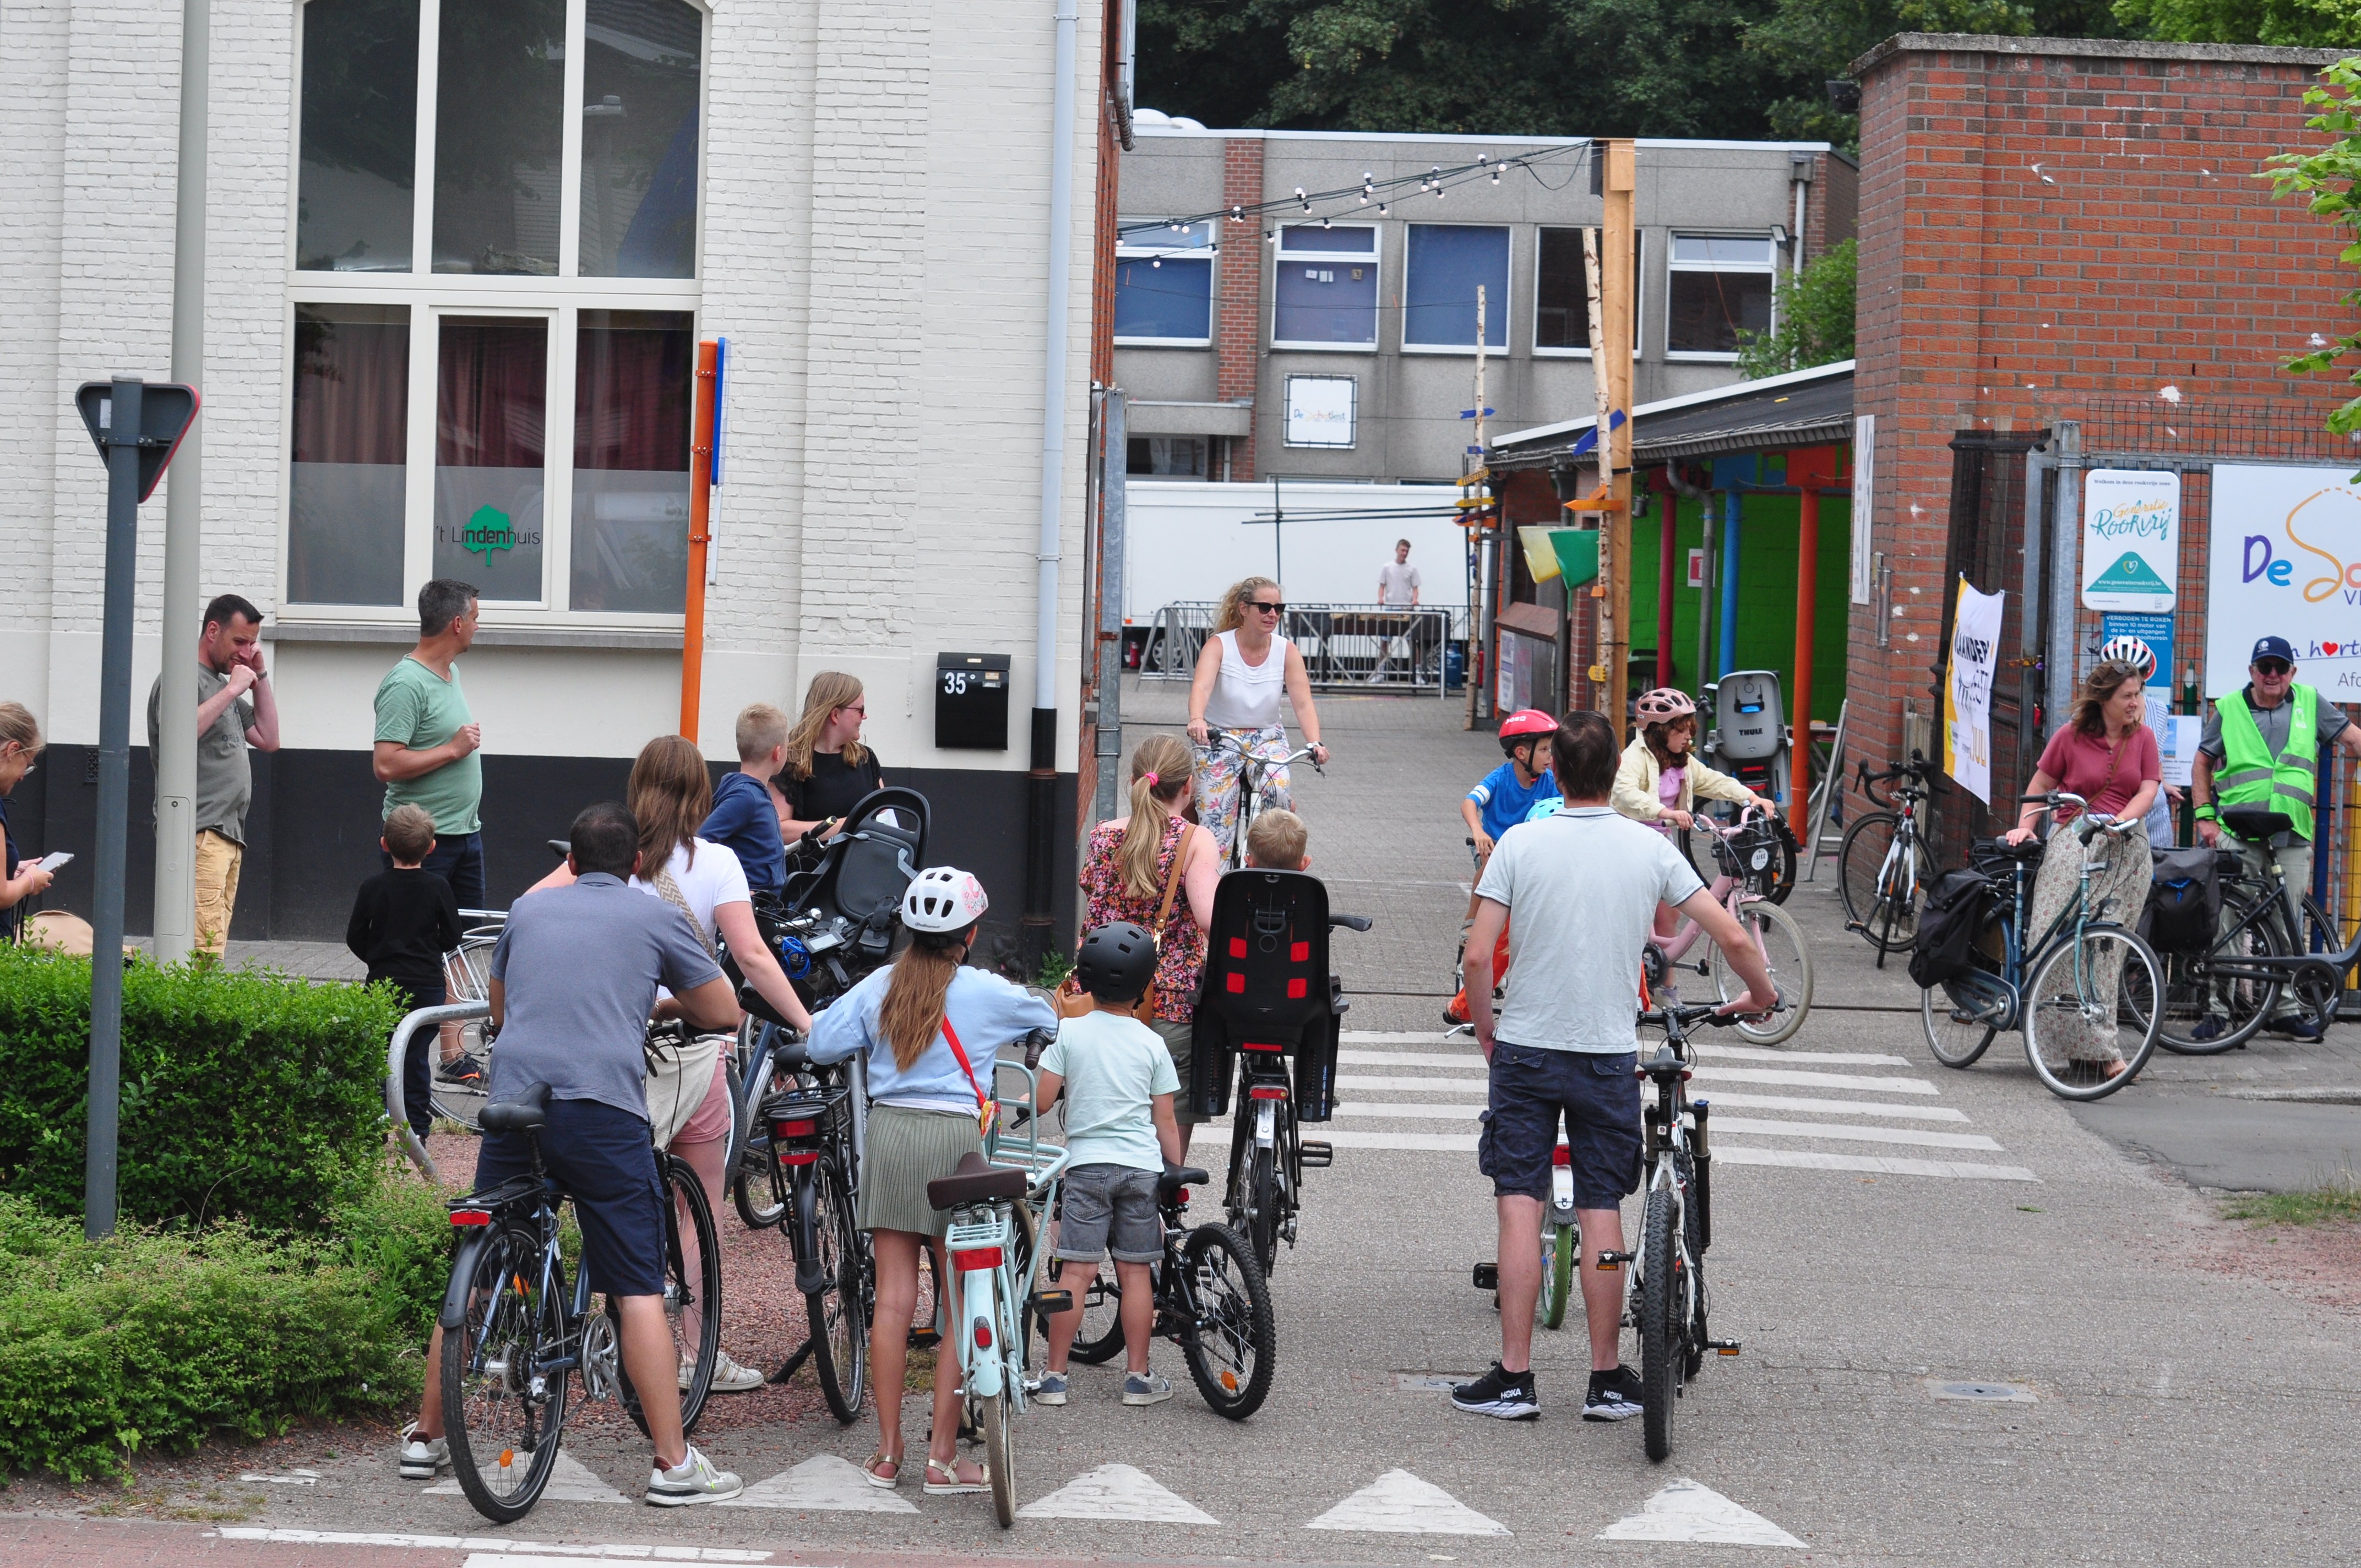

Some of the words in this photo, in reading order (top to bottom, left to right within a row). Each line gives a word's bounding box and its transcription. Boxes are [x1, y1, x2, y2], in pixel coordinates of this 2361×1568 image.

[1294, 409, 1304, 419] De
[2113, 498, 2169, 518] Generatie
[452, 525, 541, 545] Lindenhuis
[2242, 535, 2293, 586] De
[944, 672, 966, 694] 35
[1738, 727, 1763, 736] THULE
[1500, 1387, 1522, 1400] HOKA
[1603, 1390, 1623, 1401] HOKA
